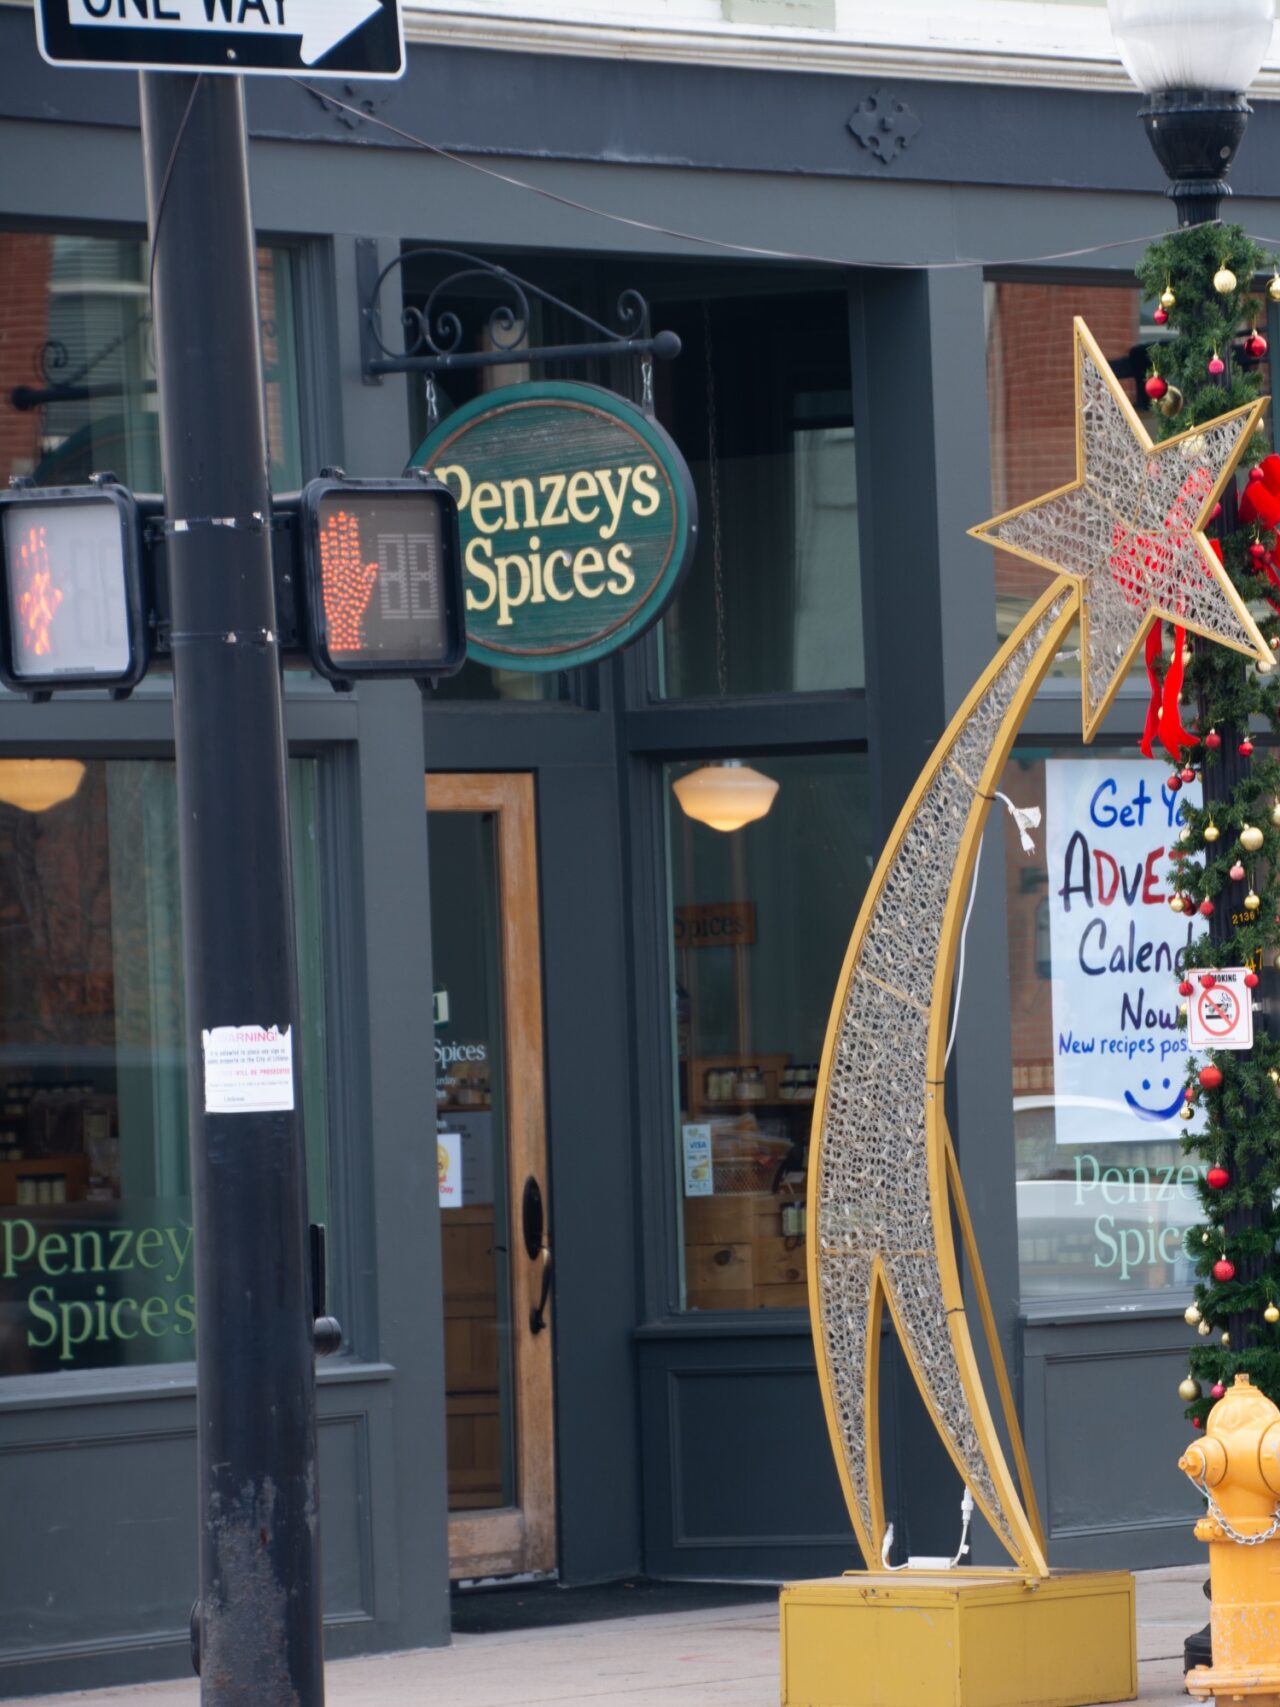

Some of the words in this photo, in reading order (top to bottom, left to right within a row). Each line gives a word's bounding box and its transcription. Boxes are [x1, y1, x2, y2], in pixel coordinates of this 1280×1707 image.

[434, 464, 660, 539] Penzeys
[465, 536, 635, 625] Spices
[1090, 778, 1152, 828] Get
[1214, 974, 1237, 983] MOKING
[1059, 1031, 1095, 1055] New
[1100, 1036, 1155, 1060] recipes
[1160, 1038, 1193, 1062] pos
[2, 1219, 193, 1282] Penzey
[27, 1285, 195, 1360] Spices
